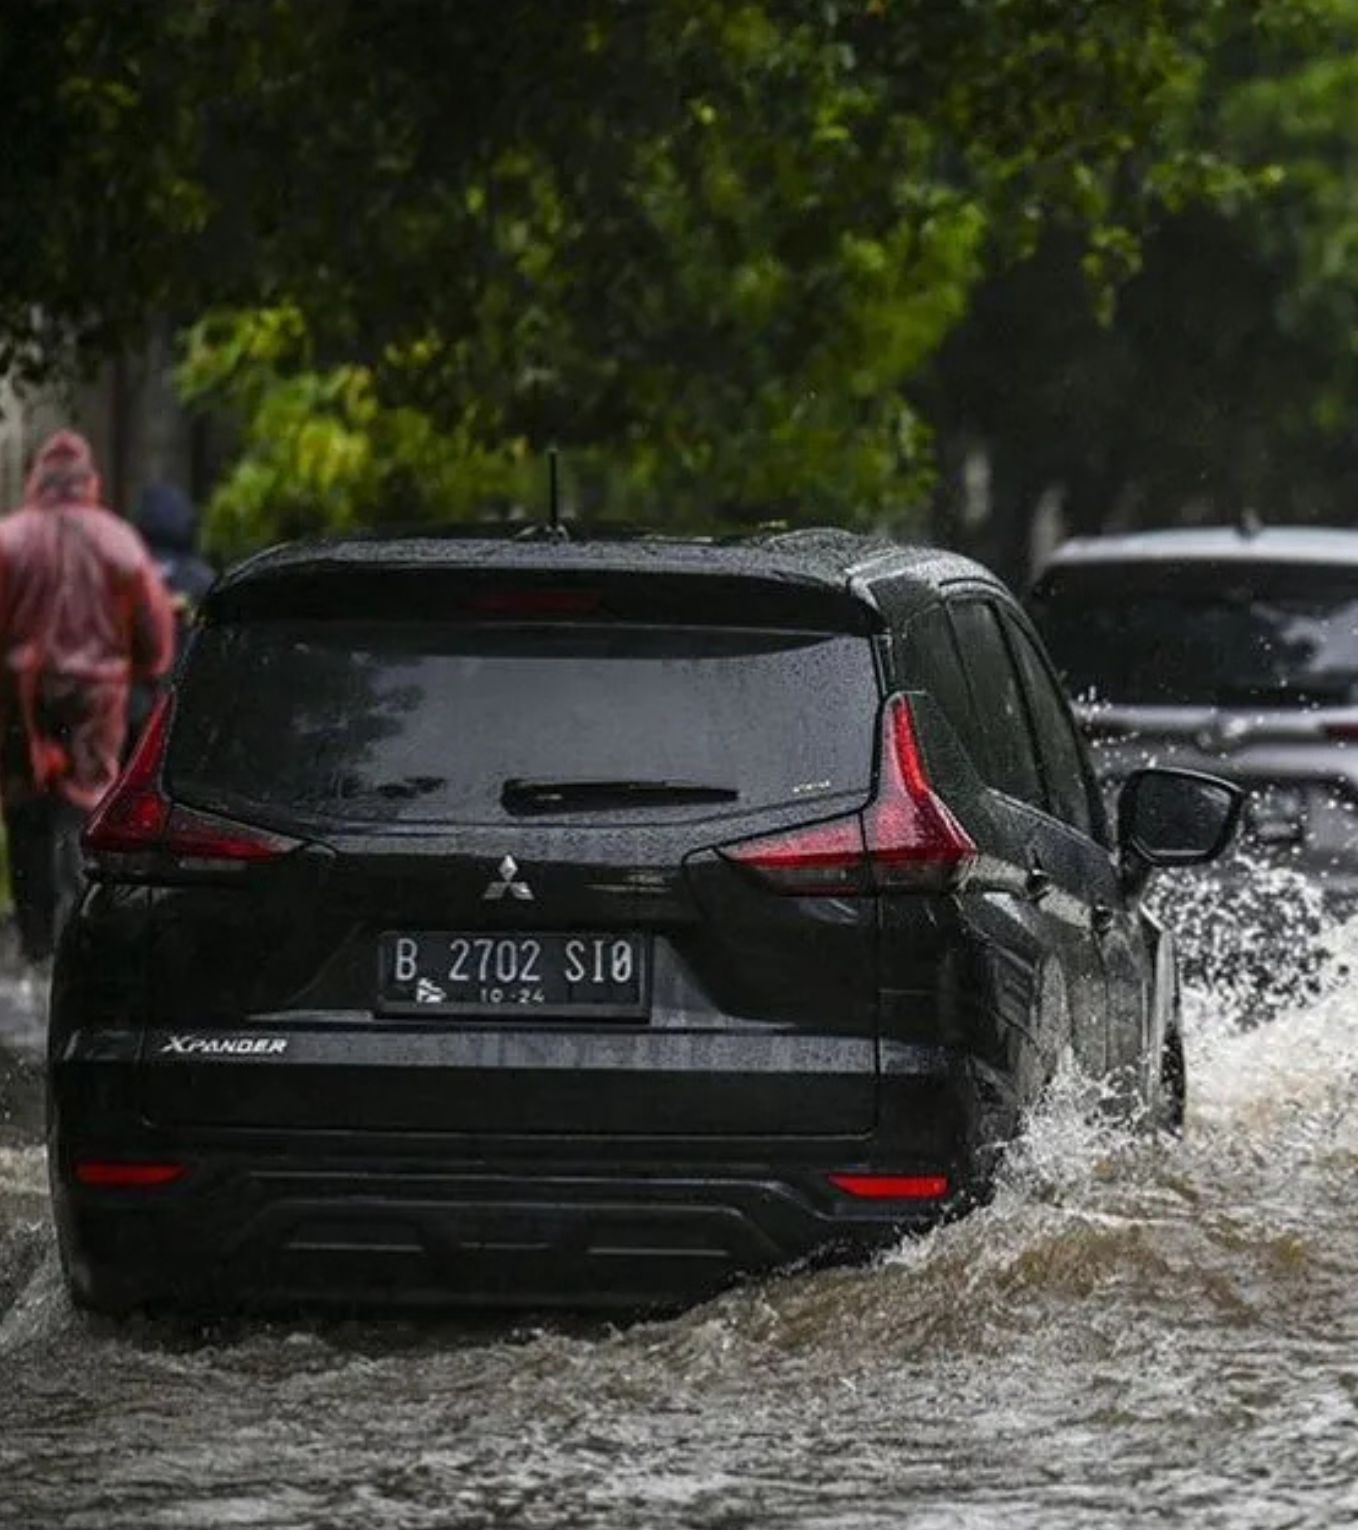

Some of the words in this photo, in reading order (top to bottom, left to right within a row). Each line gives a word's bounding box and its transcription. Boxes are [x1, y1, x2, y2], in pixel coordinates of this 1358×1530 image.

[396, 938, 418, 981] B
[449, 939, 541, 982] 2702
[161, 1035, 288, 1054] XPANDER
